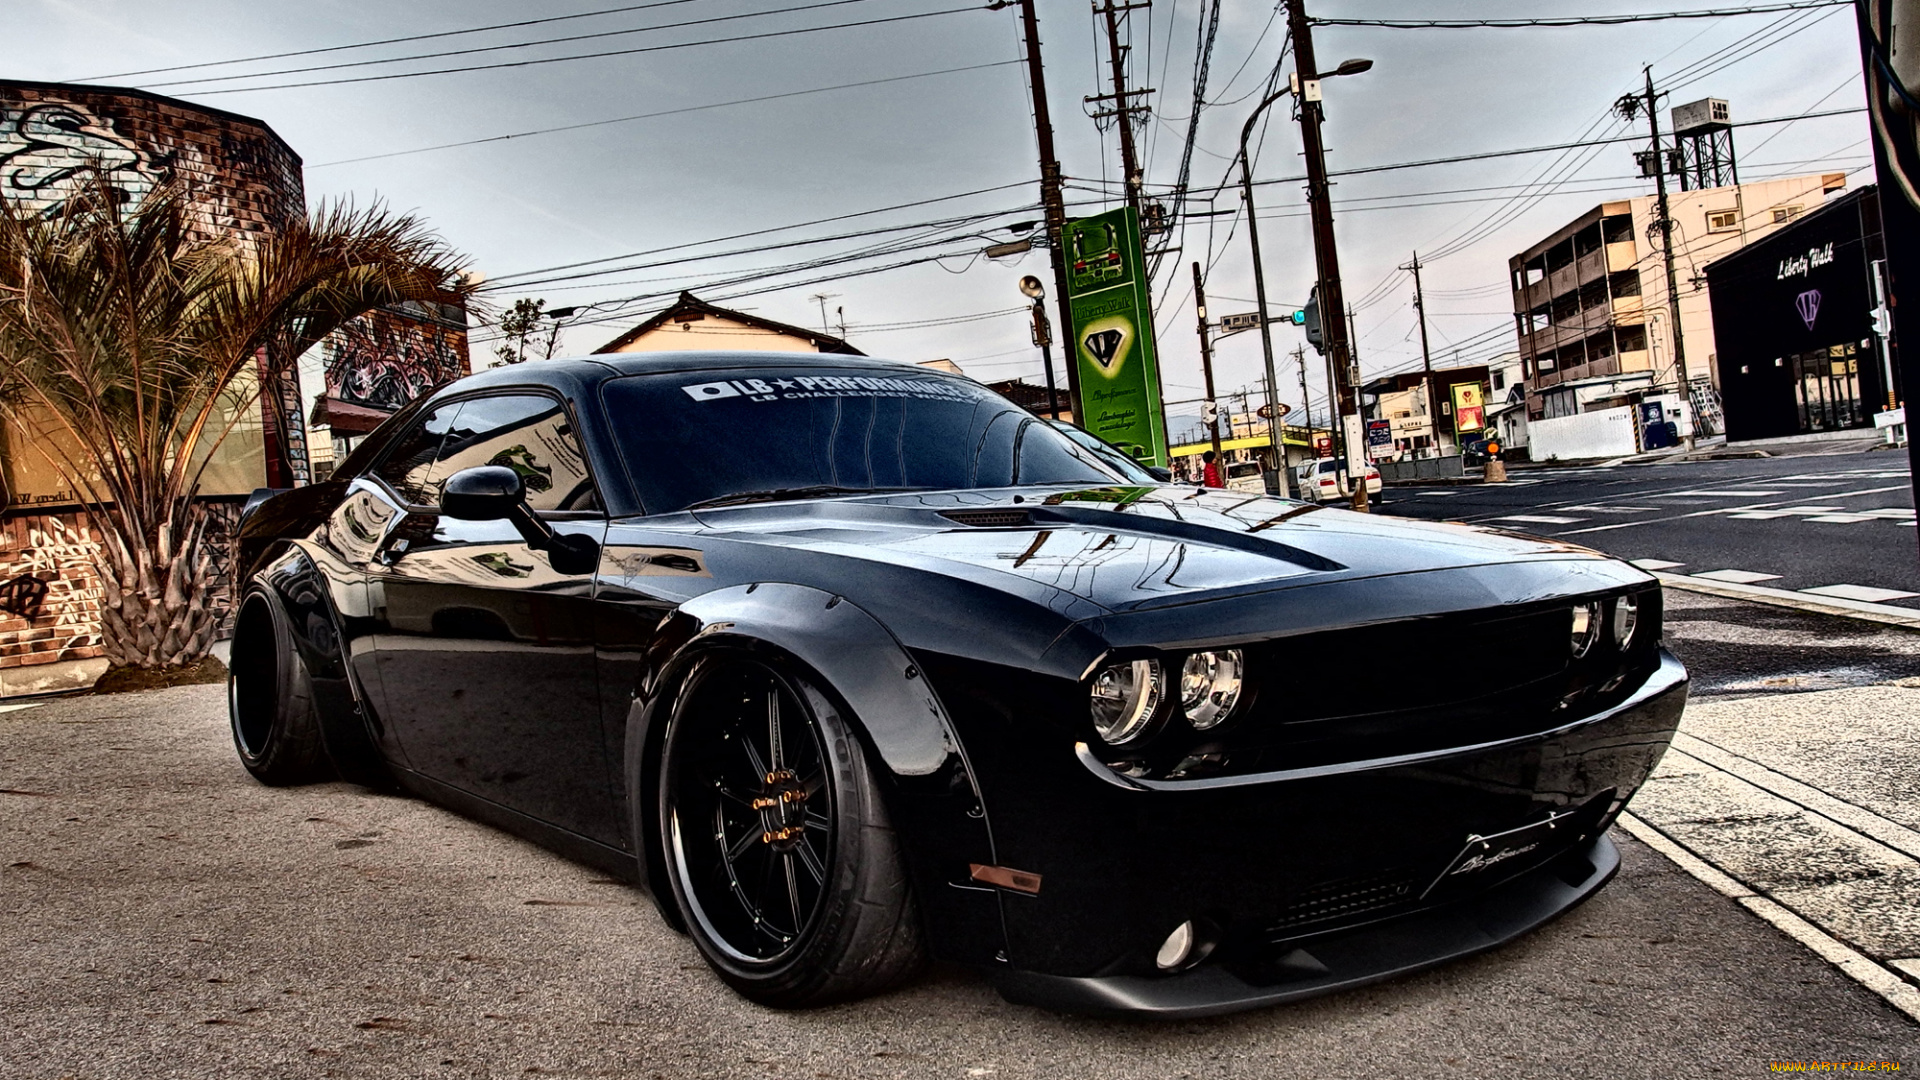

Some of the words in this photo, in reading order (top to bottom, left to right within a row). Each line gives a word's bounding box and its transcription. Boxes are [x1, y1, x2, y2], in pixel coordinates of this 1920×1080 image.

[1777, 255, 1808, 280] Liberty
[1809, 242, 1833, 268] Walk
[1107, 296, 1132, 311] Walk
[730, 379, 775, 395] LB
[793, 376, 965, 396] PERFORMANCE
[750, 394, 779, 402] LB
